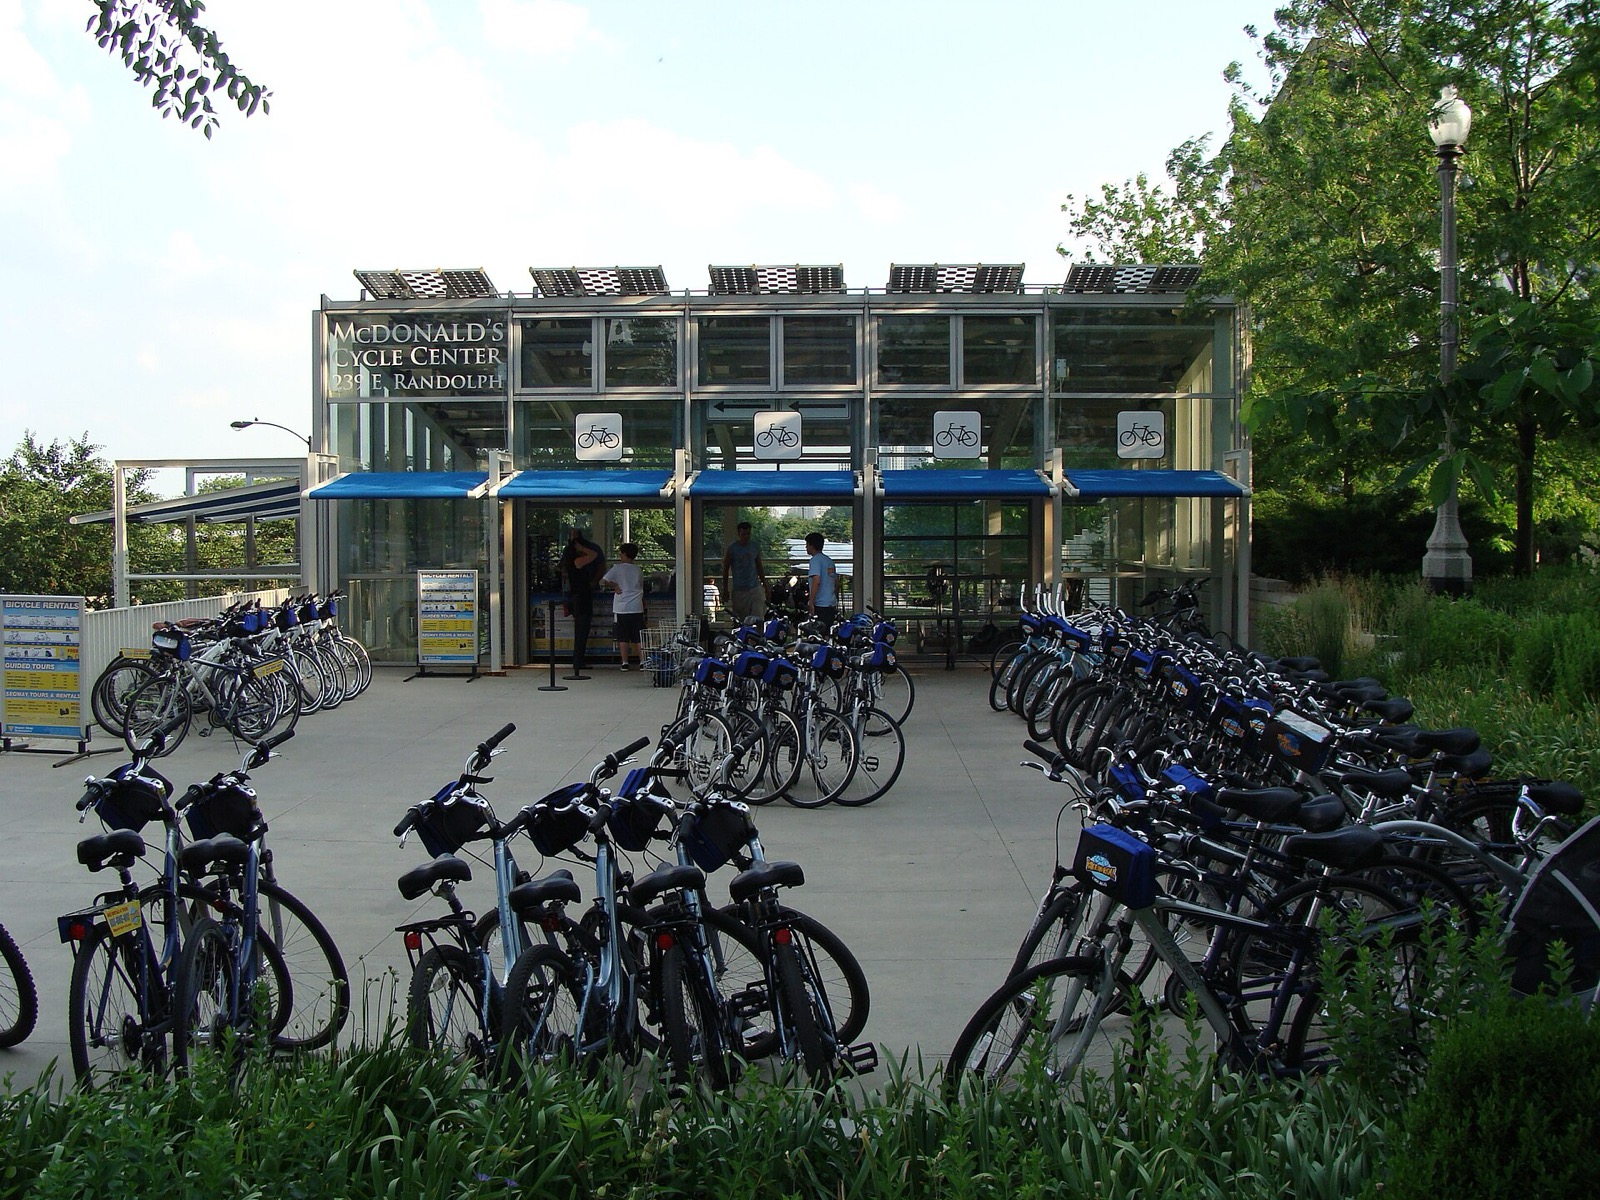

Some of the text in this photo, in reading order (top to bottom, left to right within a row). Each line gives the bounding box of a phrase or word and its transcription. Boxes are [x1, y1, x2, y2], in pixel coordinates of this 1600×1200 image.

[333, 346, 502, 367] CYCLE CENTER
[332, 374, 362, 391] 239
[394, 373, 503, 390] RANDOLPH
